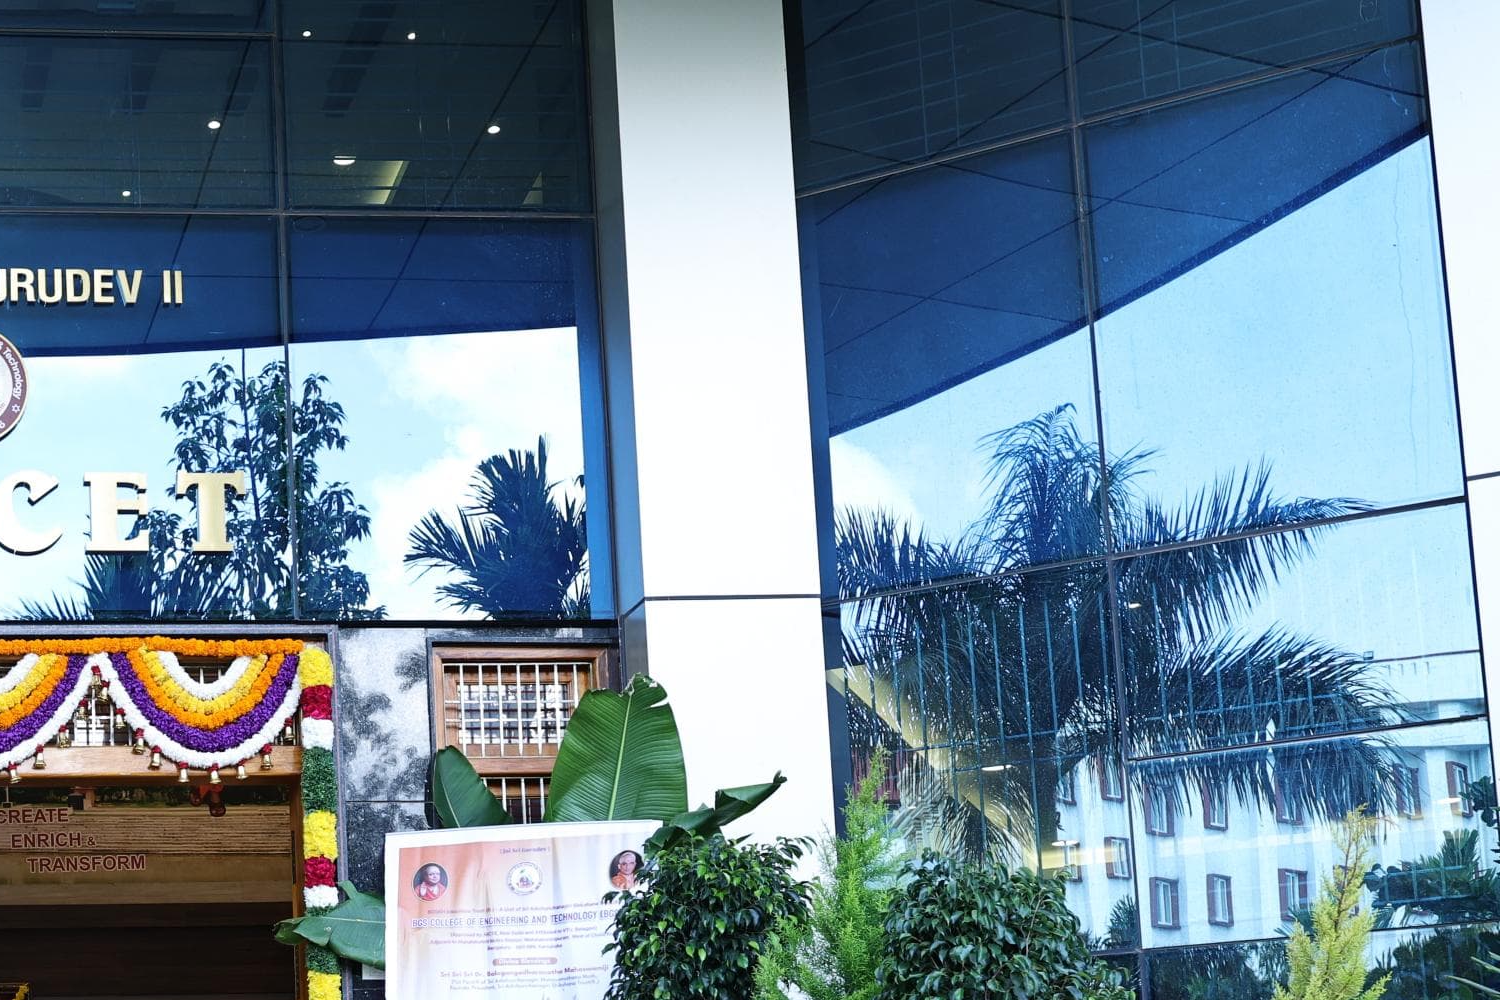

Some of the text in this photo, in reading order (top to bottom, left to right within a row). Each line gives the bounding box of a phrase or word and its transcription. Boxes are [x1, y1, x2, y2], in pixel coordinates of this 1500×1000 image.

[2, 348, 23, 399] Technology
[12, 832, 96, 848] ENRICH &
[27, 855, 145, 872] TRANSFORM
[430, 918, 464, 926] COLLEGE
[480, 916, 529, 925] ENGINEERING
[551, 911, 596, 922] TECHNOLOGY
